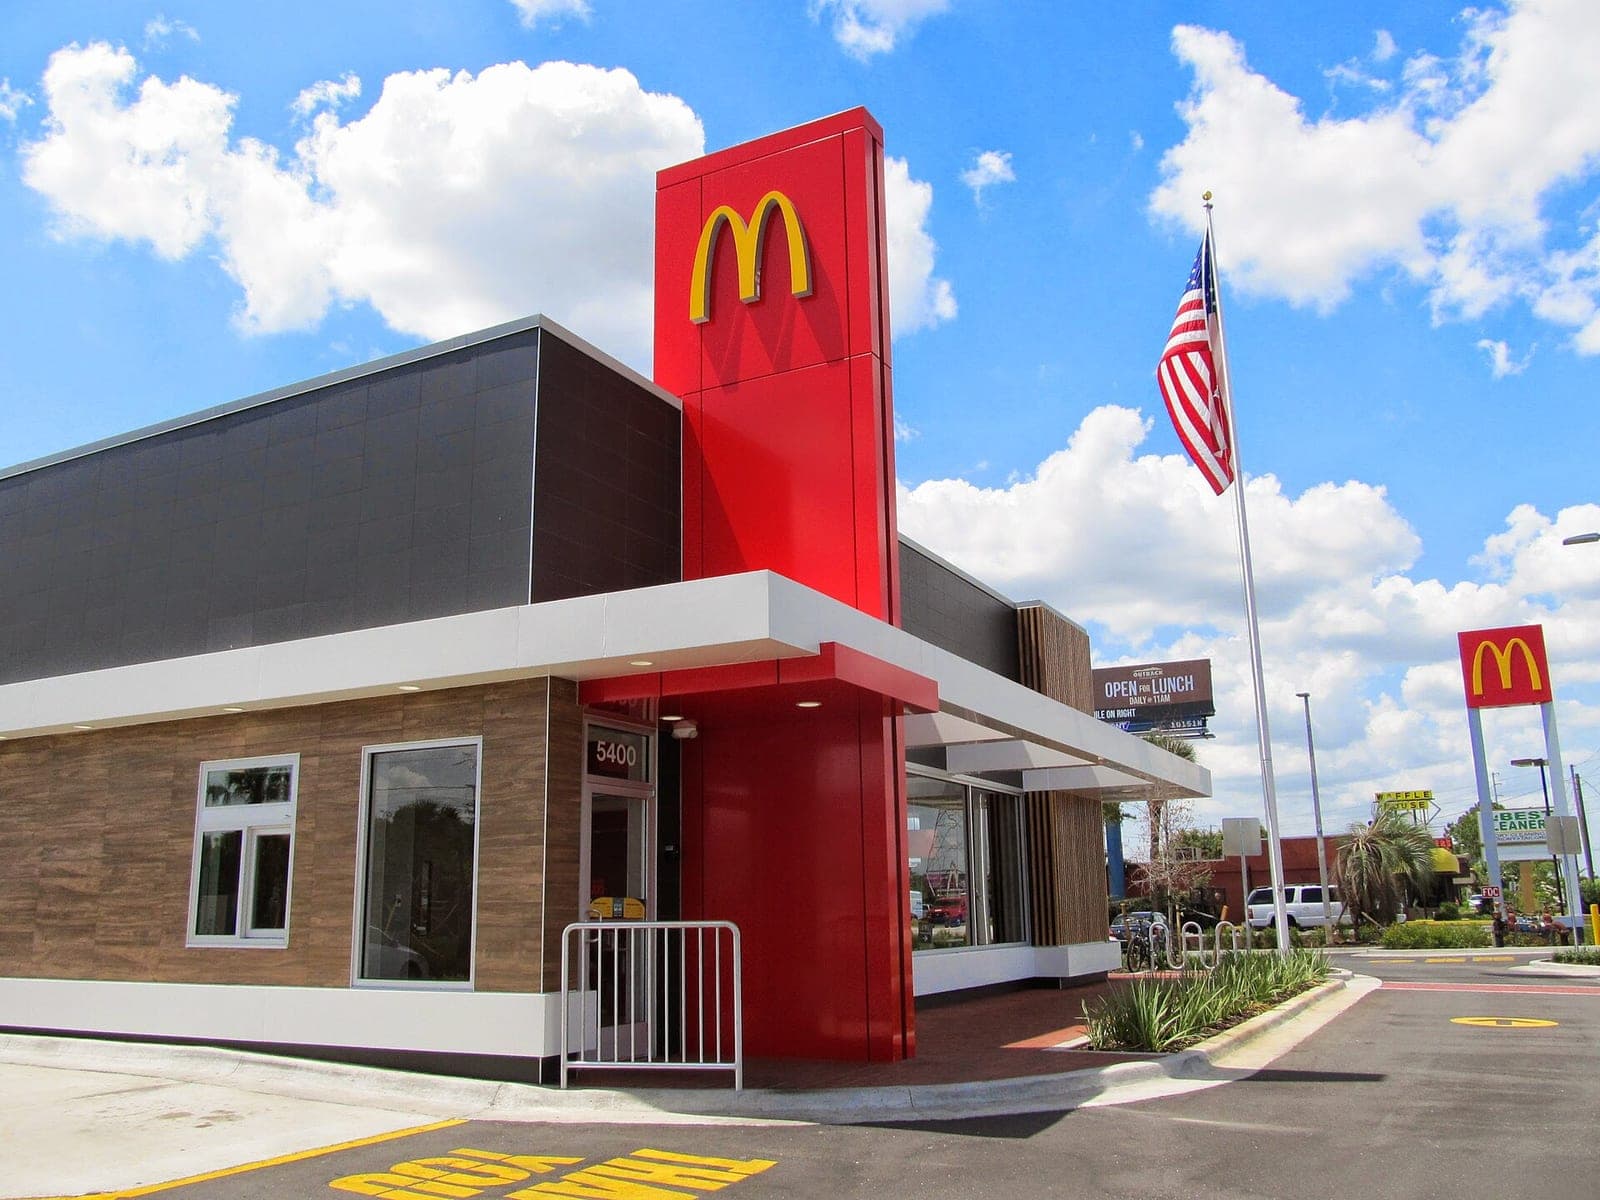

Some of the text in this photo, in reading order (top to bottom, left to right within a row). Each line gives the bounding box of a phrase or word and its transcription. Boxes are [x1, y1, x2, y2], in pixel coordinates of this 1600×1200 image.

[1132, 669, 1163, 678] OUTBACK
[1105, 674, 1194, 698] OPEN FOR LUNCH
[1129, 695, 1147, 705] DAILY
[1153, 694, 1170, 704] 11AM
[1106, 709, 1115, 719] ON
[1116, 708, 1136, 718] RIGHT
[596, 739, 637, 766] 5400
[1482, 887, 1499, 897] FDC
[328, 1147, 585, 1200] YOU
